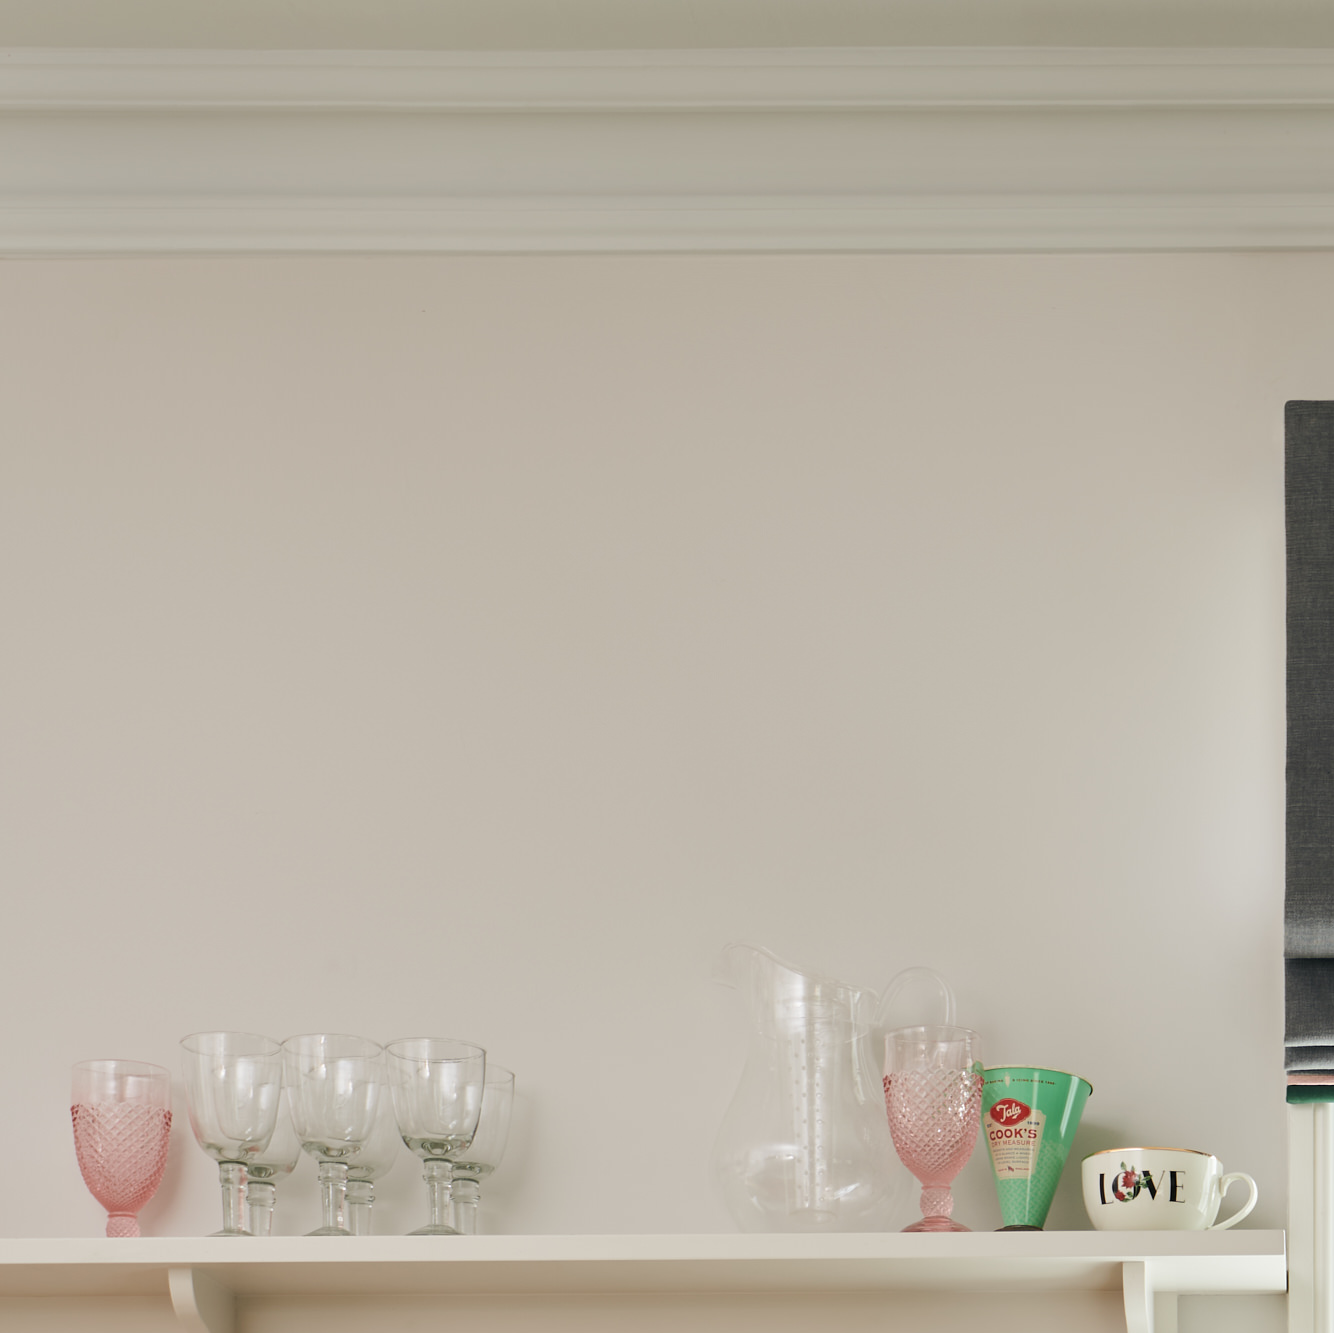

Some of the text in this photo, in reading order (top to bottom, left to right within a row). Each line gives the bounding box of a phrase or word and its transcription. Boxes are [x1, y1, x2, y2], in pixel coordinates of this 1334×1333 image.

[995, 1102, 1022, 1123] Tala
[989, 1128, 1038, 1141] COOK'S
[1002, 1139, 1037, 1147] MEASURE
[1099, 1170, 1186, 1205] LOVE
